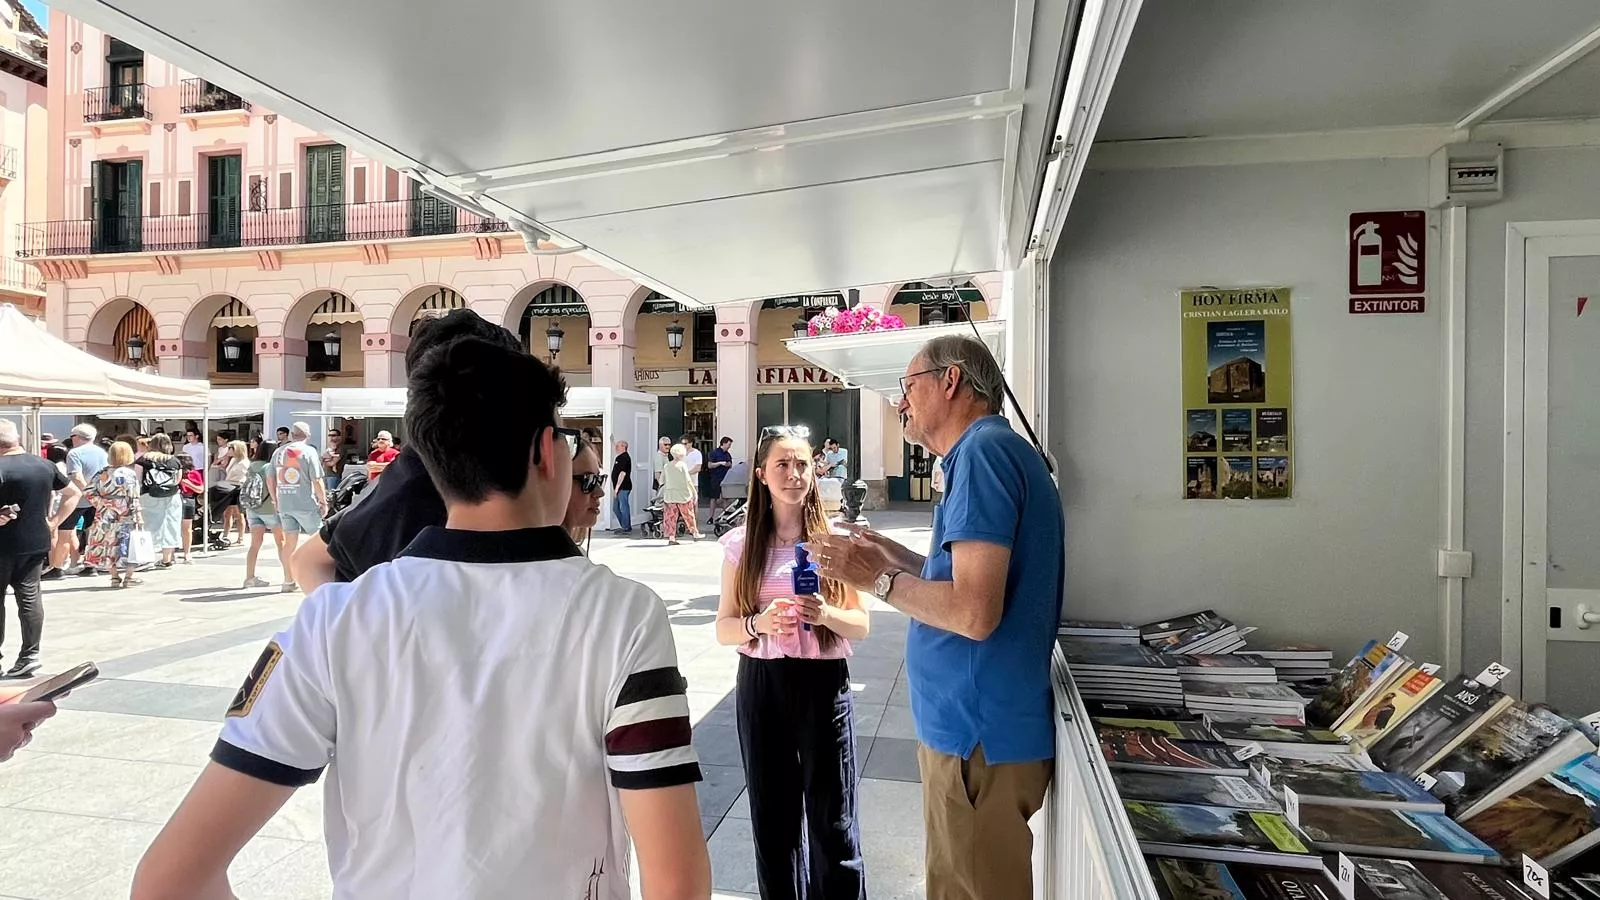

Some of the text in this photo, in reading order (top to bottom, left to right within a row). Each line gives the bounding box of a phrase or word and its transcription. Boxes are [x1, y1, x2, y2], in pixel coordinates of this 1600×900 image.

[802, 296, 810, 307] LA
[810, 295, 839, 307] CONFIANZA
[922, 292, 955, 301] desde 1871
[1193, 292, 1279, 306] HOY FIRMA
[1354, 300, 1419, 311] EXTINTOR
[1183, 310, 1221, 318] CRISTIAN
[688, 367, 714, 385] LA
[1454, 690, 1481, 705] ANSÓ
